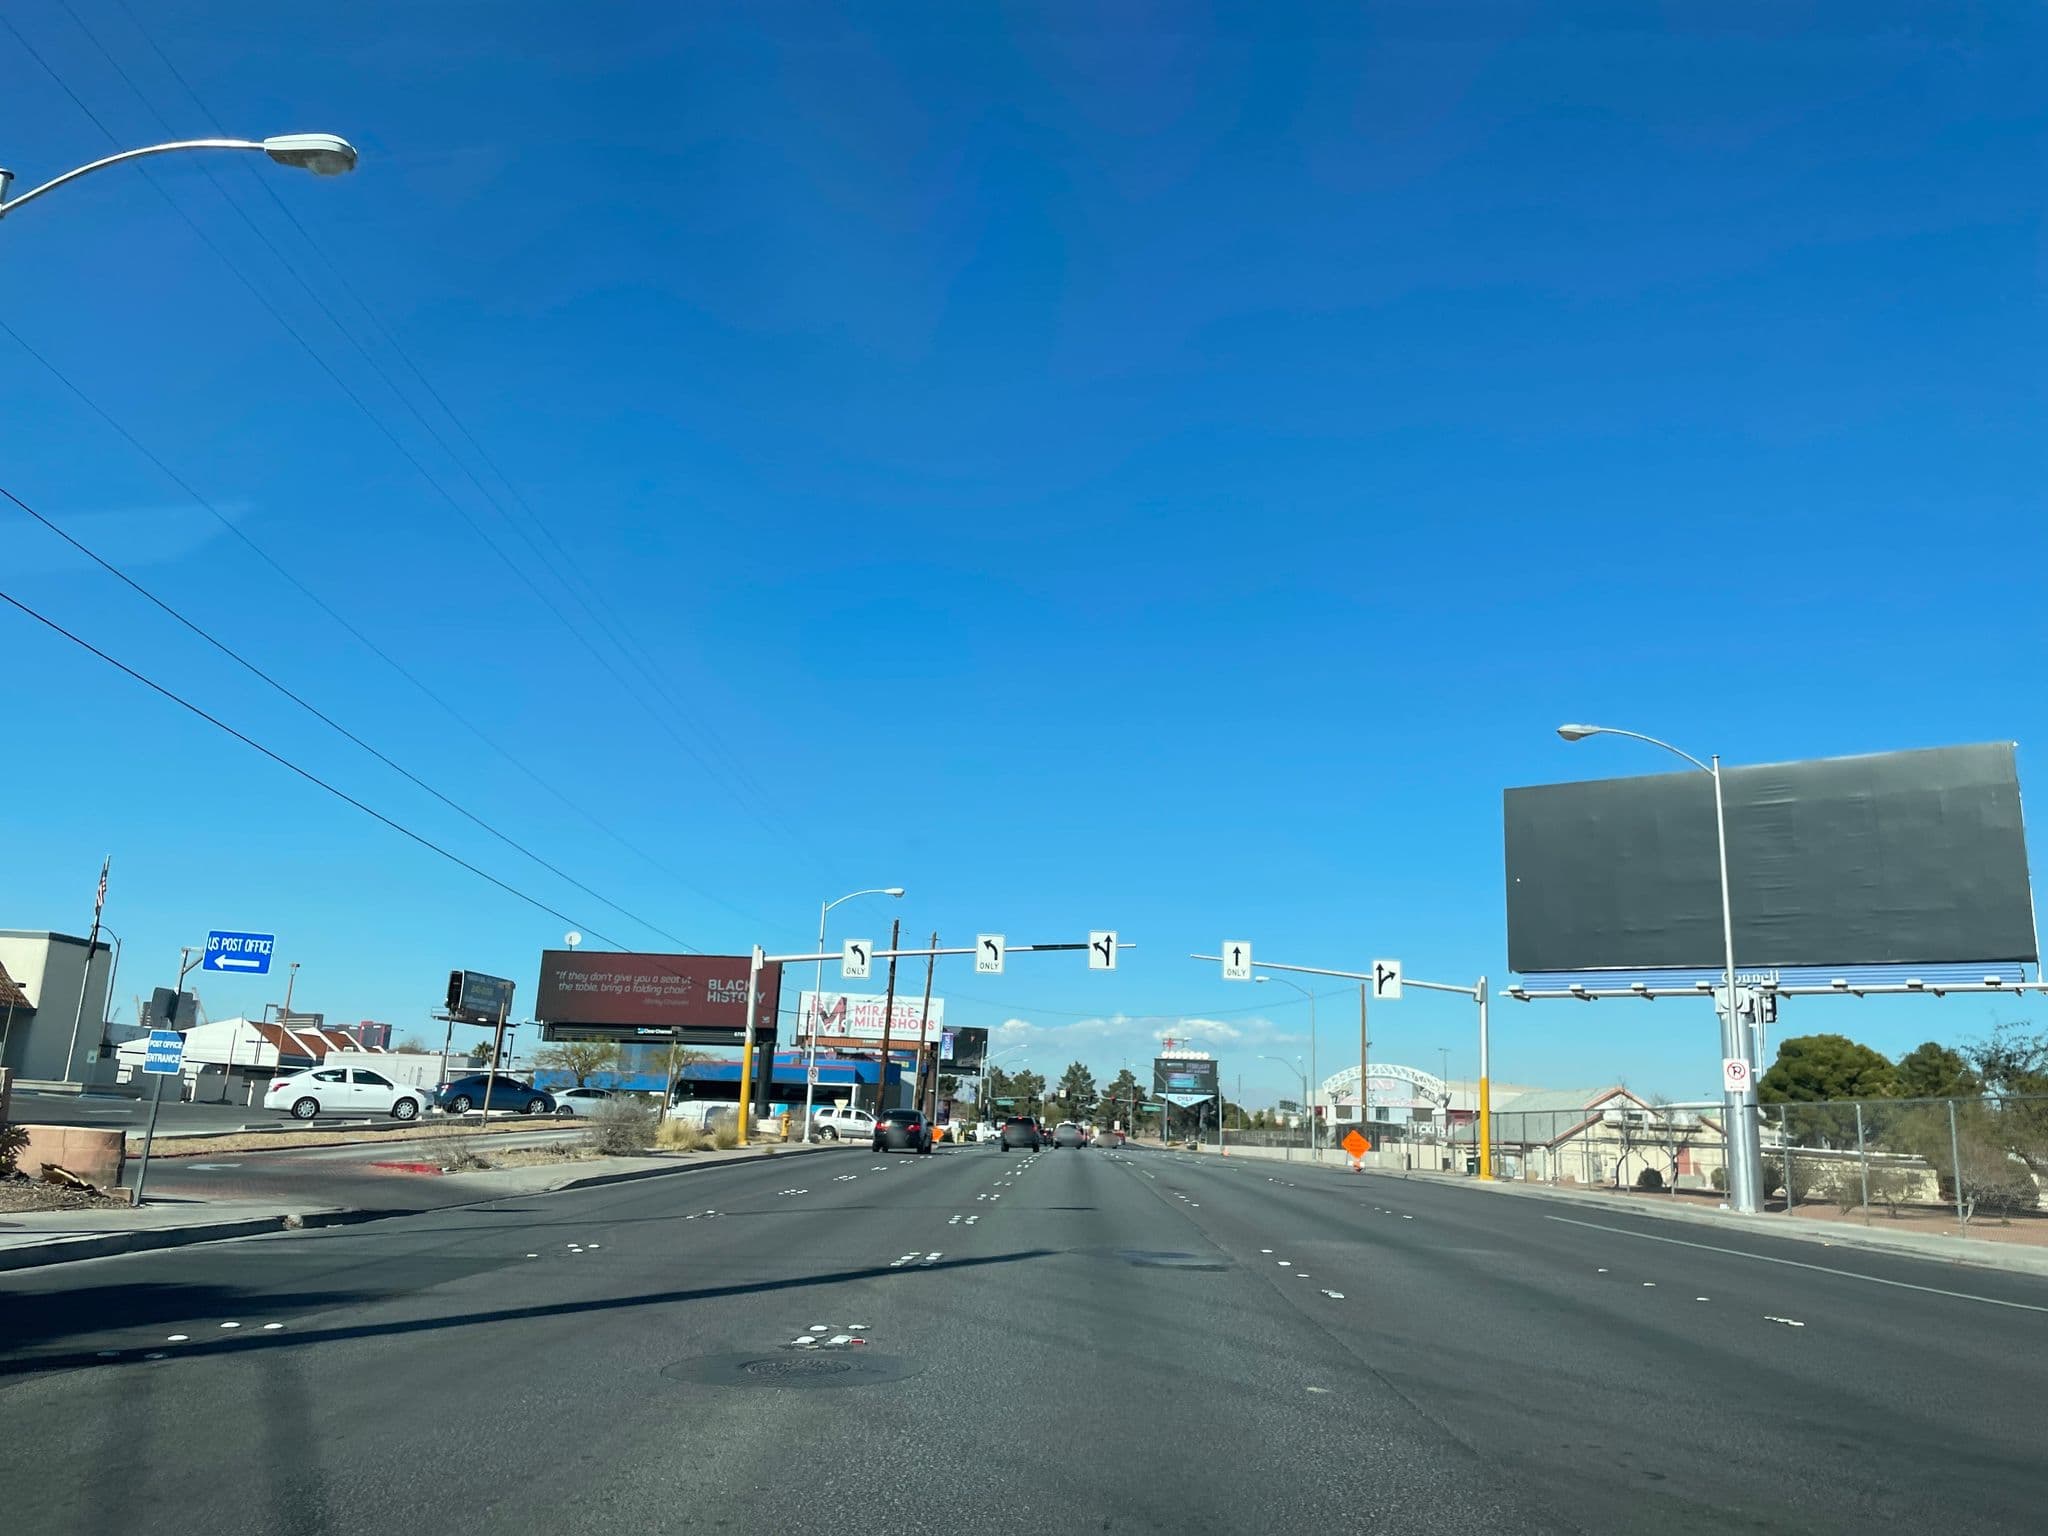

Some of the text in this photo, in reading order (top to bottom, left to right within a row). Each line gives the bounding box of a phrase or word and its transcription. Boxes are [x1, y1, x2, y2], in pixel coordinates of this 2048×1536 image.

[207, 936, 273, 954] US POST OFFICE
[846, 967, 866, 975] ONLY
[979, 962, 1000, 970] ONLY
[568, 971, 589, 982] they
[590, 972, 613, 981] don't
[614, 974, 632, 984] give
[633, 975, 651, 984] you
[652, 976, 659, 984] a
[660, 975, 681, 984] seat
[1226, 968, 1247, 977] ONLY
[558, 982, 572, 991] the
[600, 983, 623, 994] bring
[624, 985, 631, 993] a
[633, 984, 663, 996] folding
[707, 991, 766, 1004] HISTOY
[854, 1017, 885, 1028] MILE
[150, 1040, 183, 1049] POST OFFICE
[147, 1052, 181, 1064] ENTRANCE
